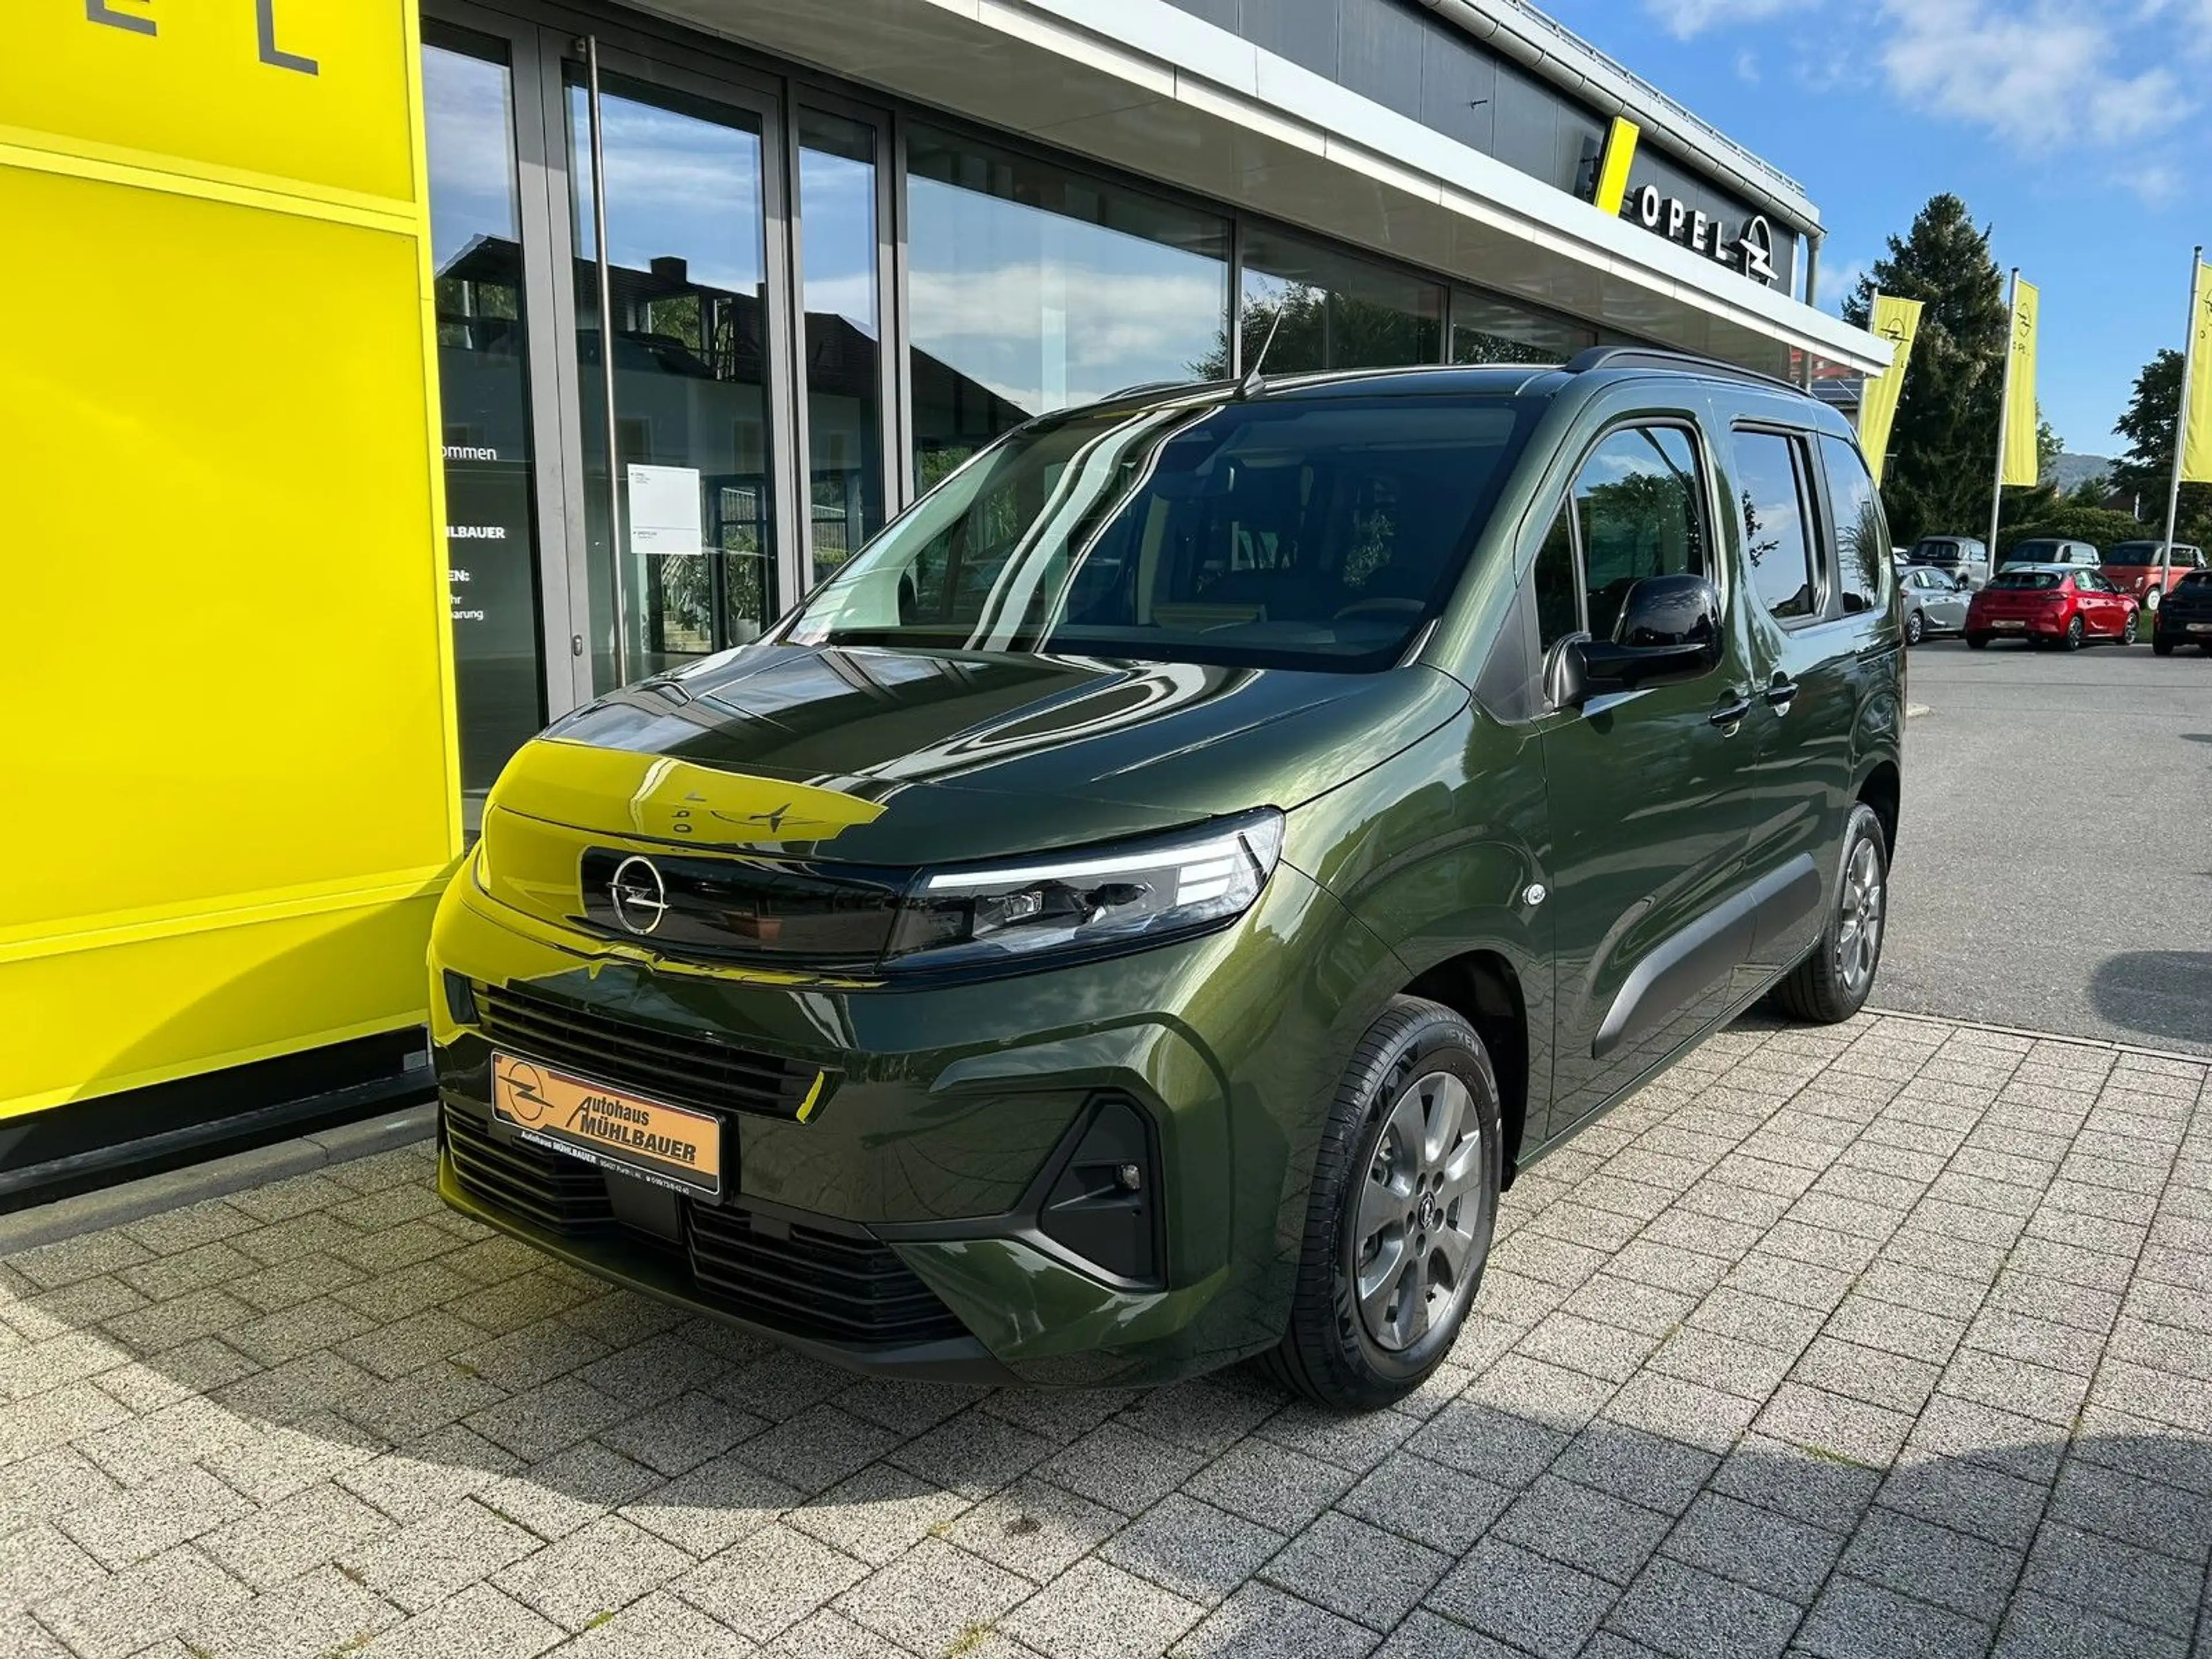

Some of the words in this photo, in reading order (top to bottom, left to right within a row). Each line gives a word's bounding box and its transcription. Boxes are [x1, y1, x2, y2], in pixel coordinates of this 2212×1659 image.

[1642, 184, 1728, 261] OPEL
[566, 1096, 650, 1127] Autohaus
[580, 1111, 697, 1161] MÜHLBAUER
